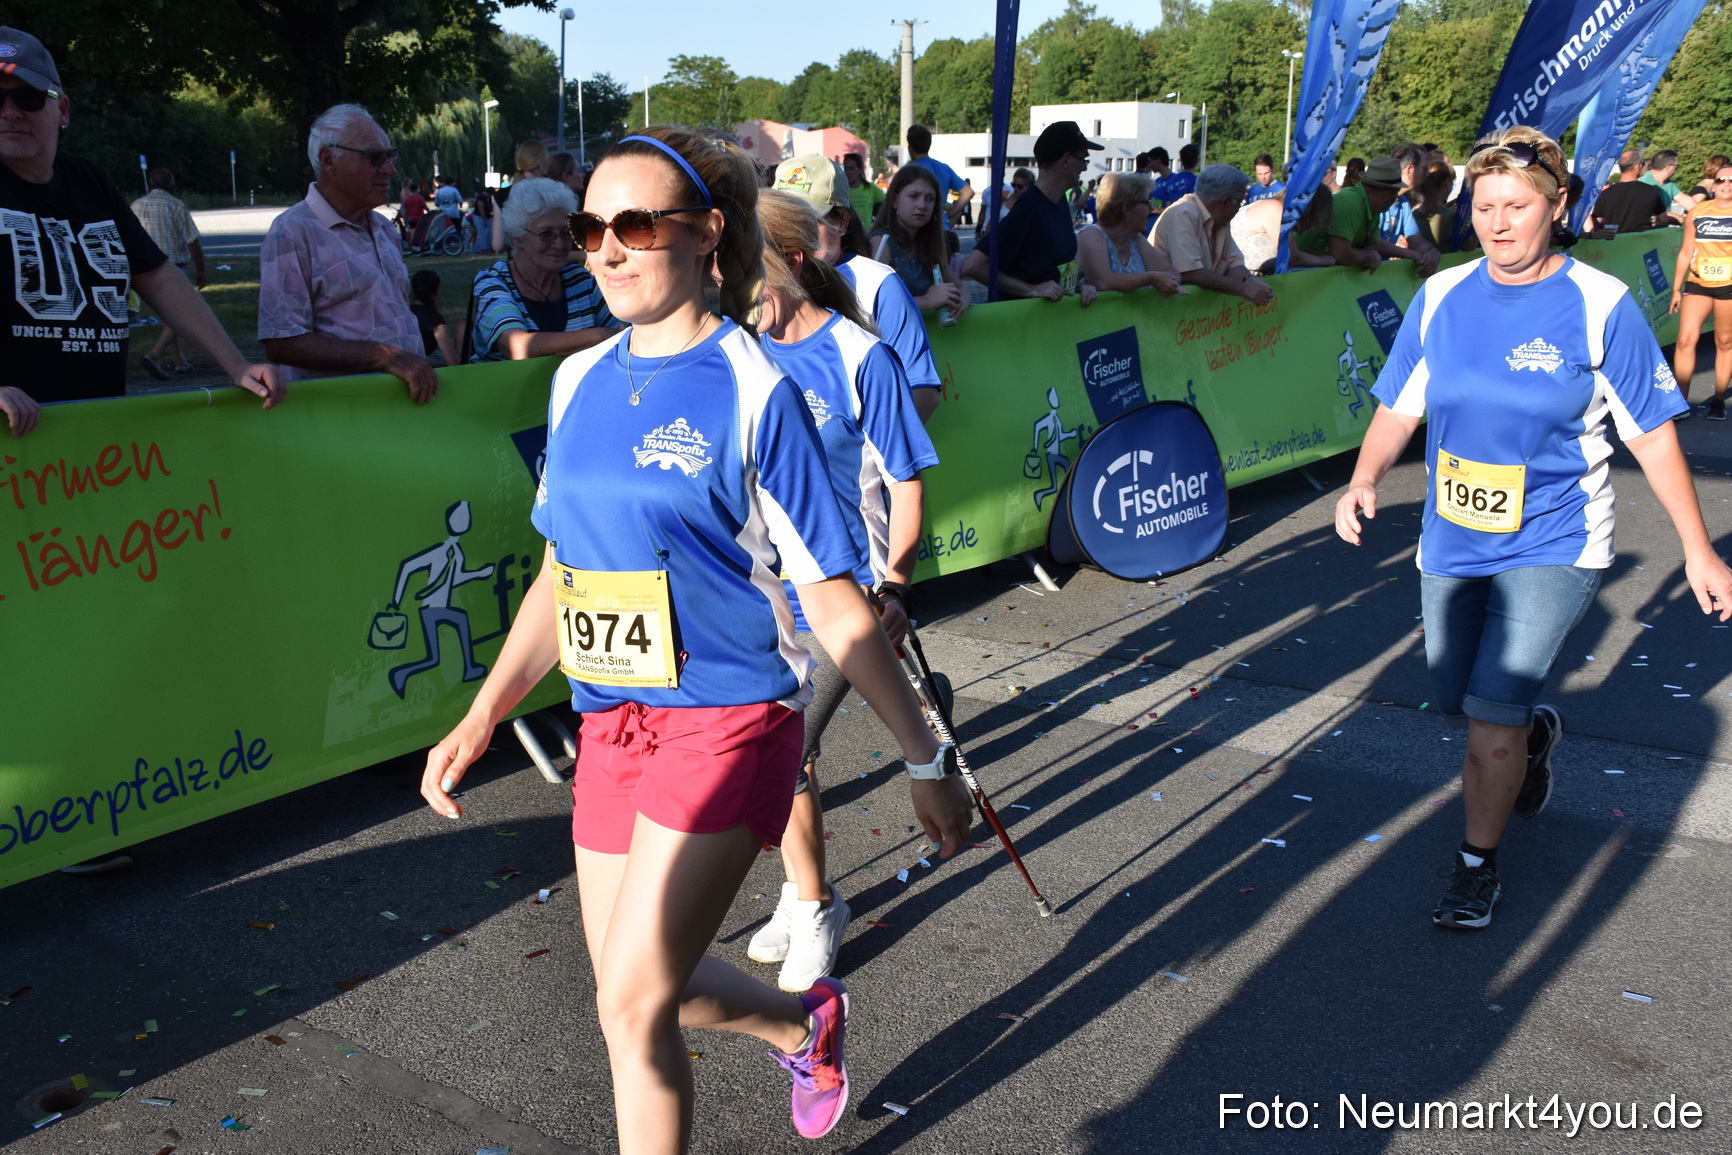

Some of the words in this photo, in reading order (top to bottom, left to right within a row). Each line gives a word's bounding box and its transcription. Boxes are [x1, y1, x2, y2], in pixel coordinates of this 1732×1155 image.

[1577, 31, 1613, 71] Druck
[1702, 224, 1732, 233] Fische
[1703, 266, 1723, 275] 596
[12, 325, 63, 339] UNCLE
[69, 327, 96, 339] SAM
[1176, 301, 1234, 346] Gesunde
[62, 341, 93, 352] EST.
[1204, 336, 1245, 372] laufen
[1512, 352, 1559, 361] TRANSpofix
[1093, 356, 1132, 381] Fischer
[1100, 371, 1130, 387] AUTOMOBILE
[643, 438, 706, 457] TRANSpofix
[1119, 471, 1208, 521] Fischer
[1444, 479, 1508, 514] 1962
[1136, 502, 1209, 539] AUTOMOBILE
[1469, 511, 1501, 521] Manuela
[17, 478, 232, 591] länger!
[563, 607, 652, 655] 1974
[575, 651, 606, 666] Schick
[608, 655, 632, 667] Sina
[575, 662, 611, 675] TRANSpofix
[612, 667, 635, 676] GmbH
